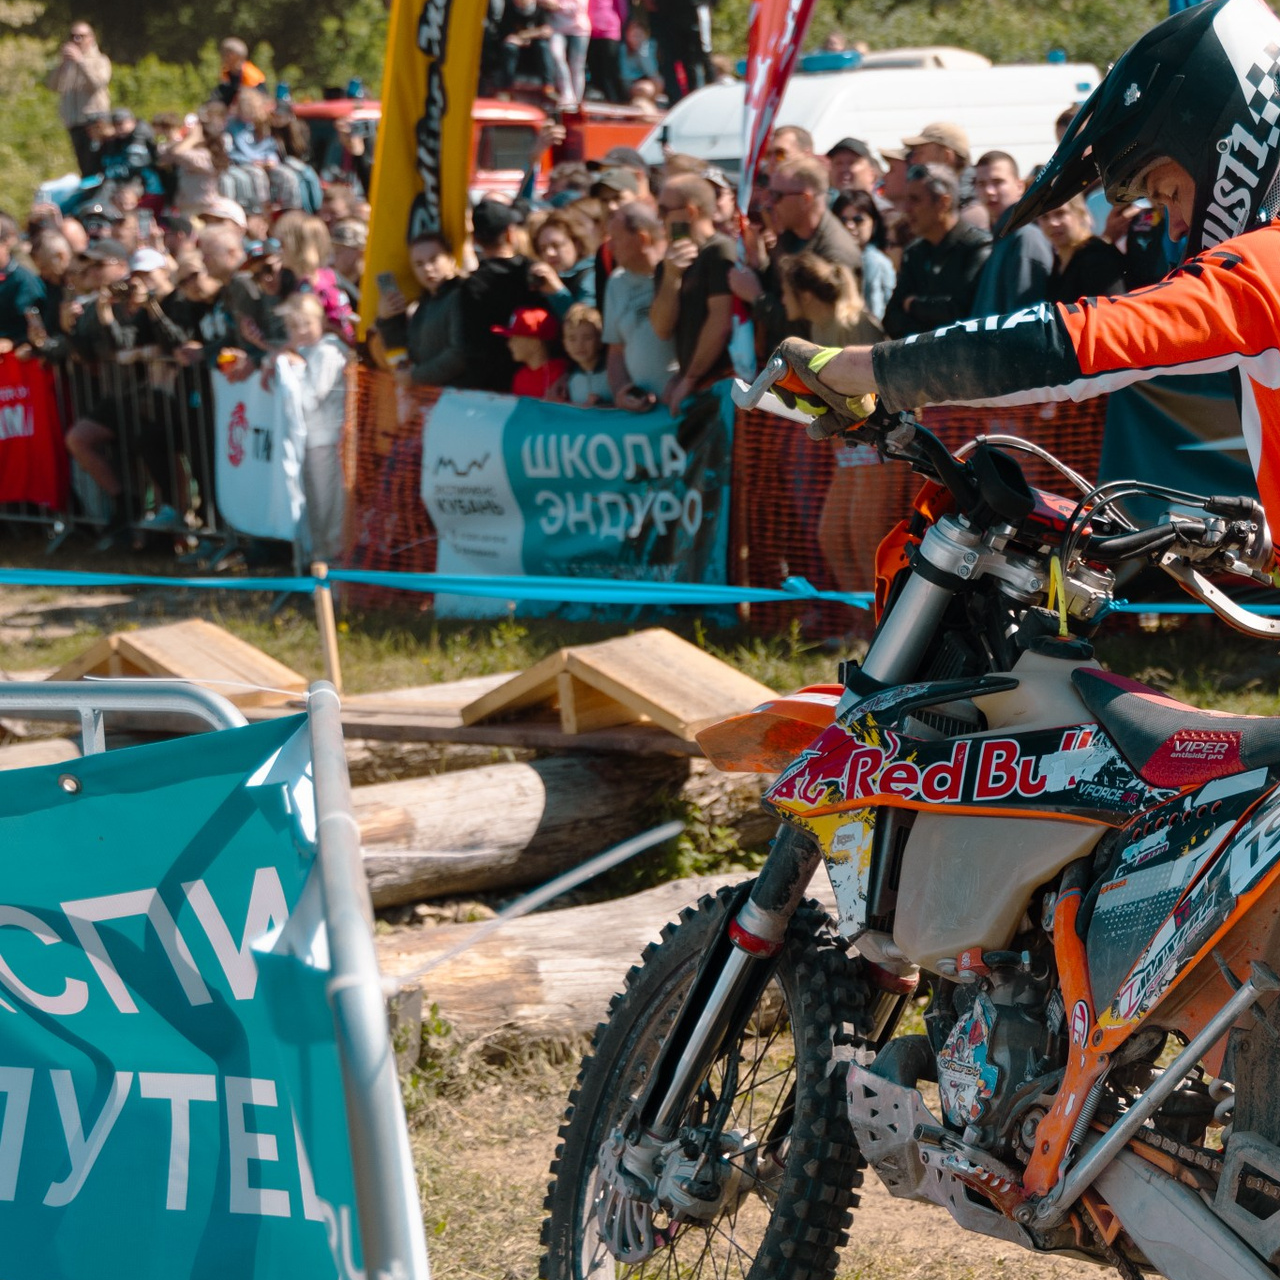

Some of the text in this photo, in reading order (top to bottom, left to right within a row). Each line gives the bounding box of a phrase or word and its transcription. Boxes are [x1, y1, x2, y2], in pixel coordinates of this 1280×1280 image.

[520, 432, 688, 481] ШКОЛА
[534, 489, 703, 542] ЭНДУРО
[1174, 739, 1230, 754] VIPER
[1207, 753, 1224, 761] pro
[845, 739, 973, 804] Red
